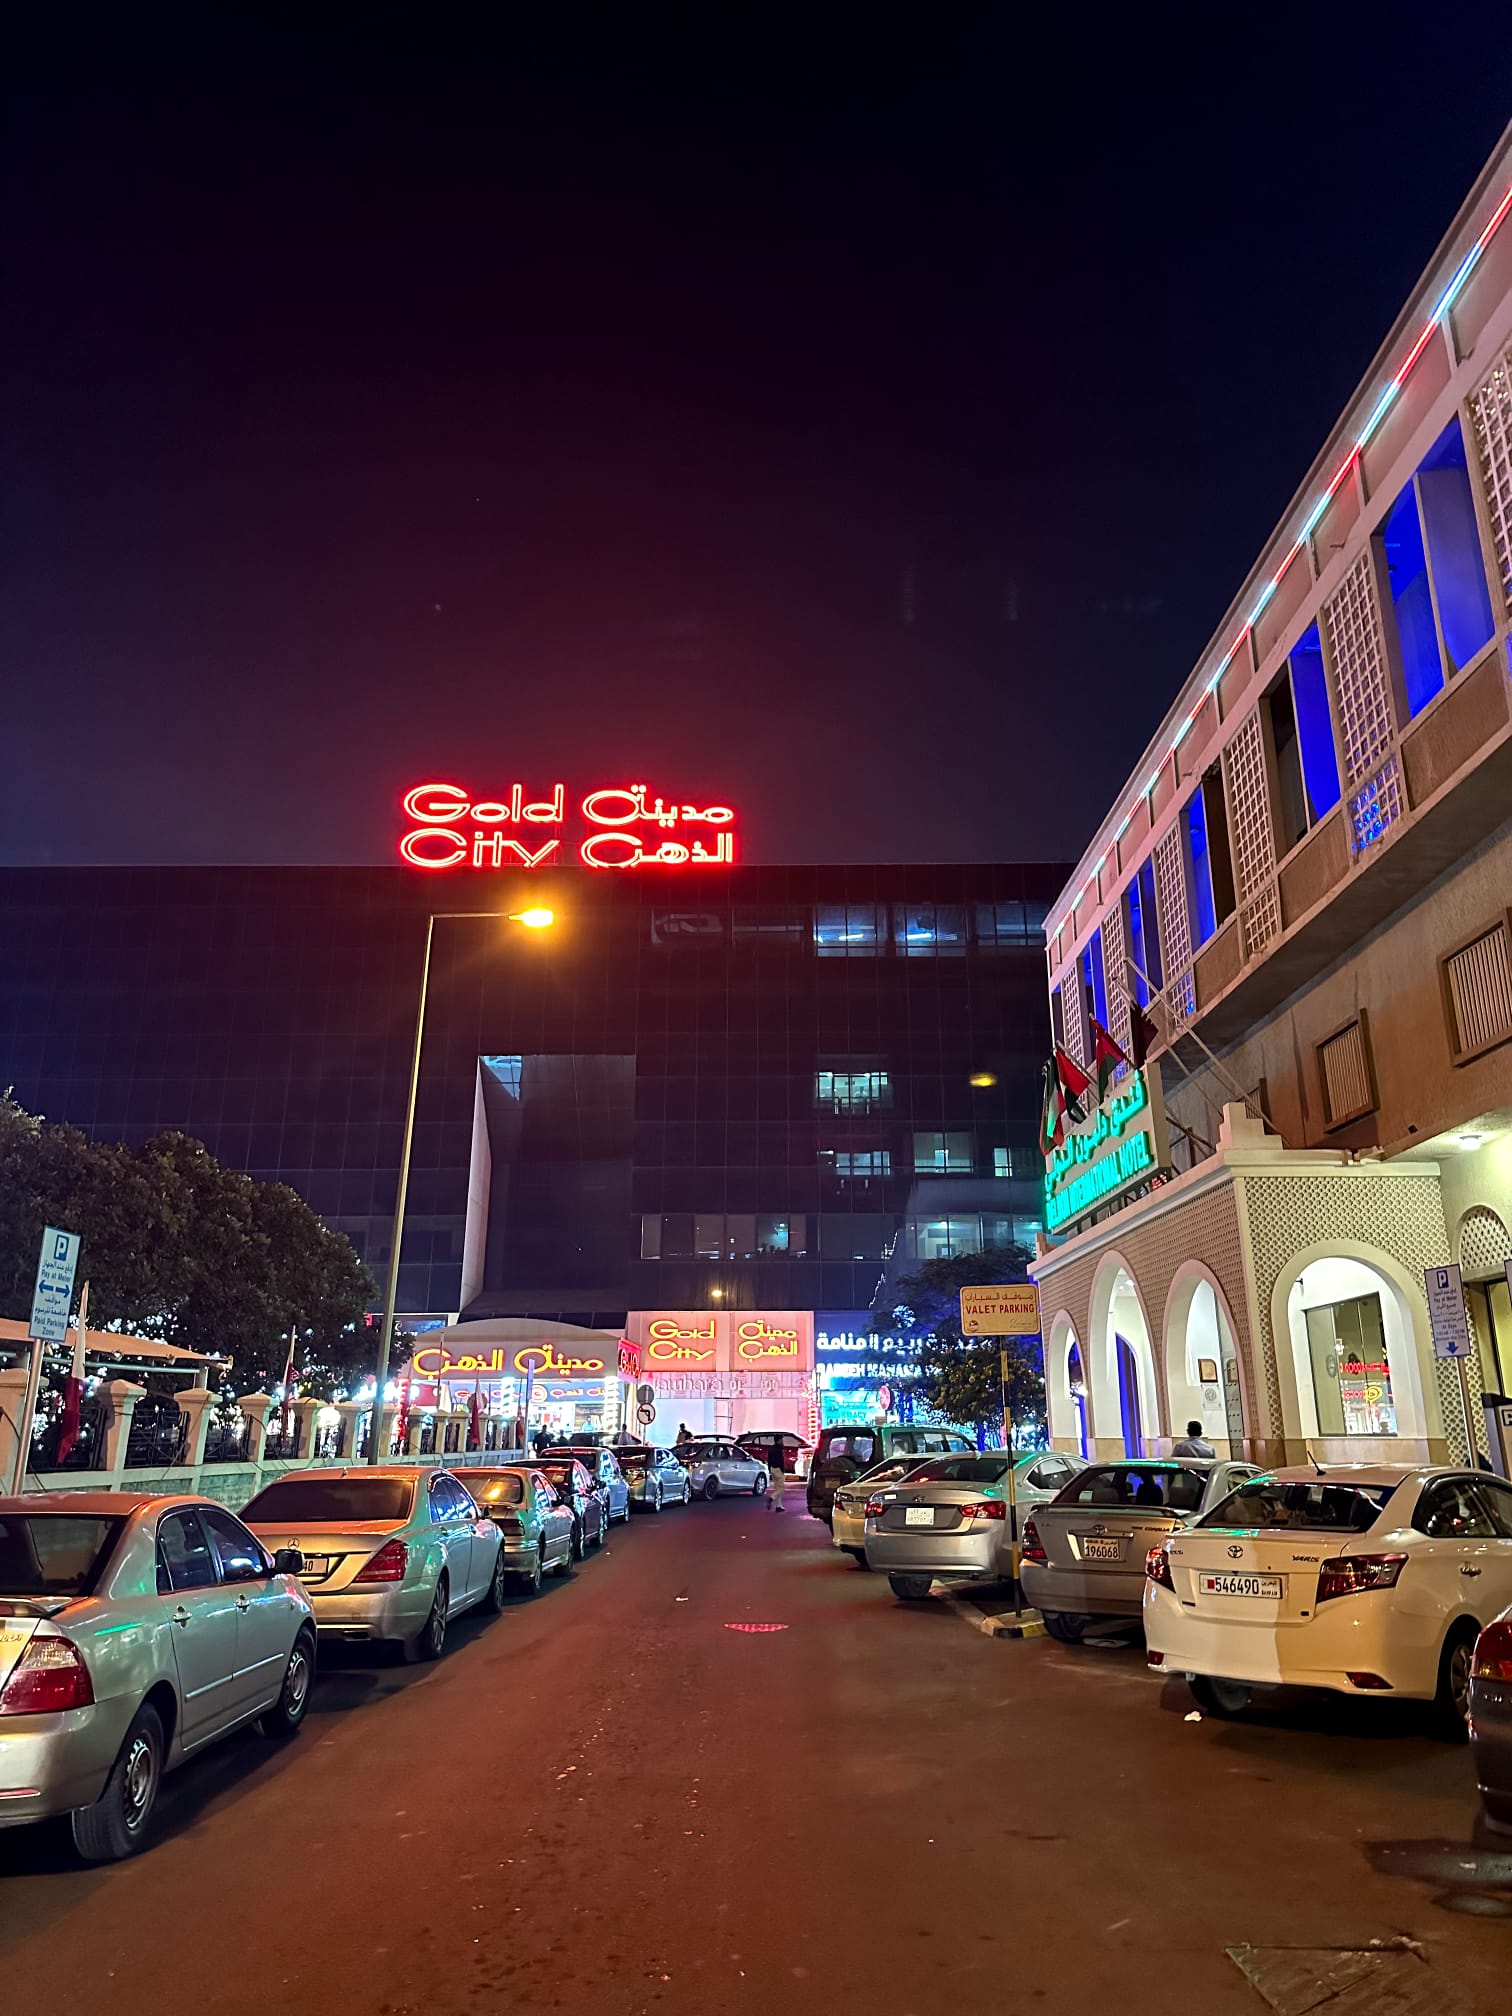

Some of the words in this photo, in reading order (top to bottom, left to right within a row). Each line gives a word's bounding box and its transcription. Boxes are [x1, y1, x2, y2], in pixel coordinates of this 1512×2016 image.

[404, 784, 564, 823] Gold
[582, 784, 733, 827] مدينة
[400, 828, 560, 867] City
[581, 833, 733, 868] الذهب
[1110, 1069, 1147, 1137] فندق
[1119, 1131, 1150, 1180] HOTEL
[42, 1269, 50, 1279] Pay
[966, 1305, 996, 1314] VALET
[1000, 1303, 1034, 1313] PARKING
[34, 1316, 46, 1325] Paid
[46, 1317, 65, 1330] Parking
[42, 1327, 55, 1336] Zone
[649, 1320, 715, 1339] Gold
[738, 1319, 797, 1341] مدينة
[649, 1340, 714, 1360] City
[738, 1341, 798, 1363] الذهب
[816, 1332, 879, 1350] المنامة
[413, 1348, 504, 1380] الذهب
[514, 1343, 604, 1376] مدينة
[1086, 1546, 1118, 1558] 196068
[1215, 1577, 1259, 1595] 546490
